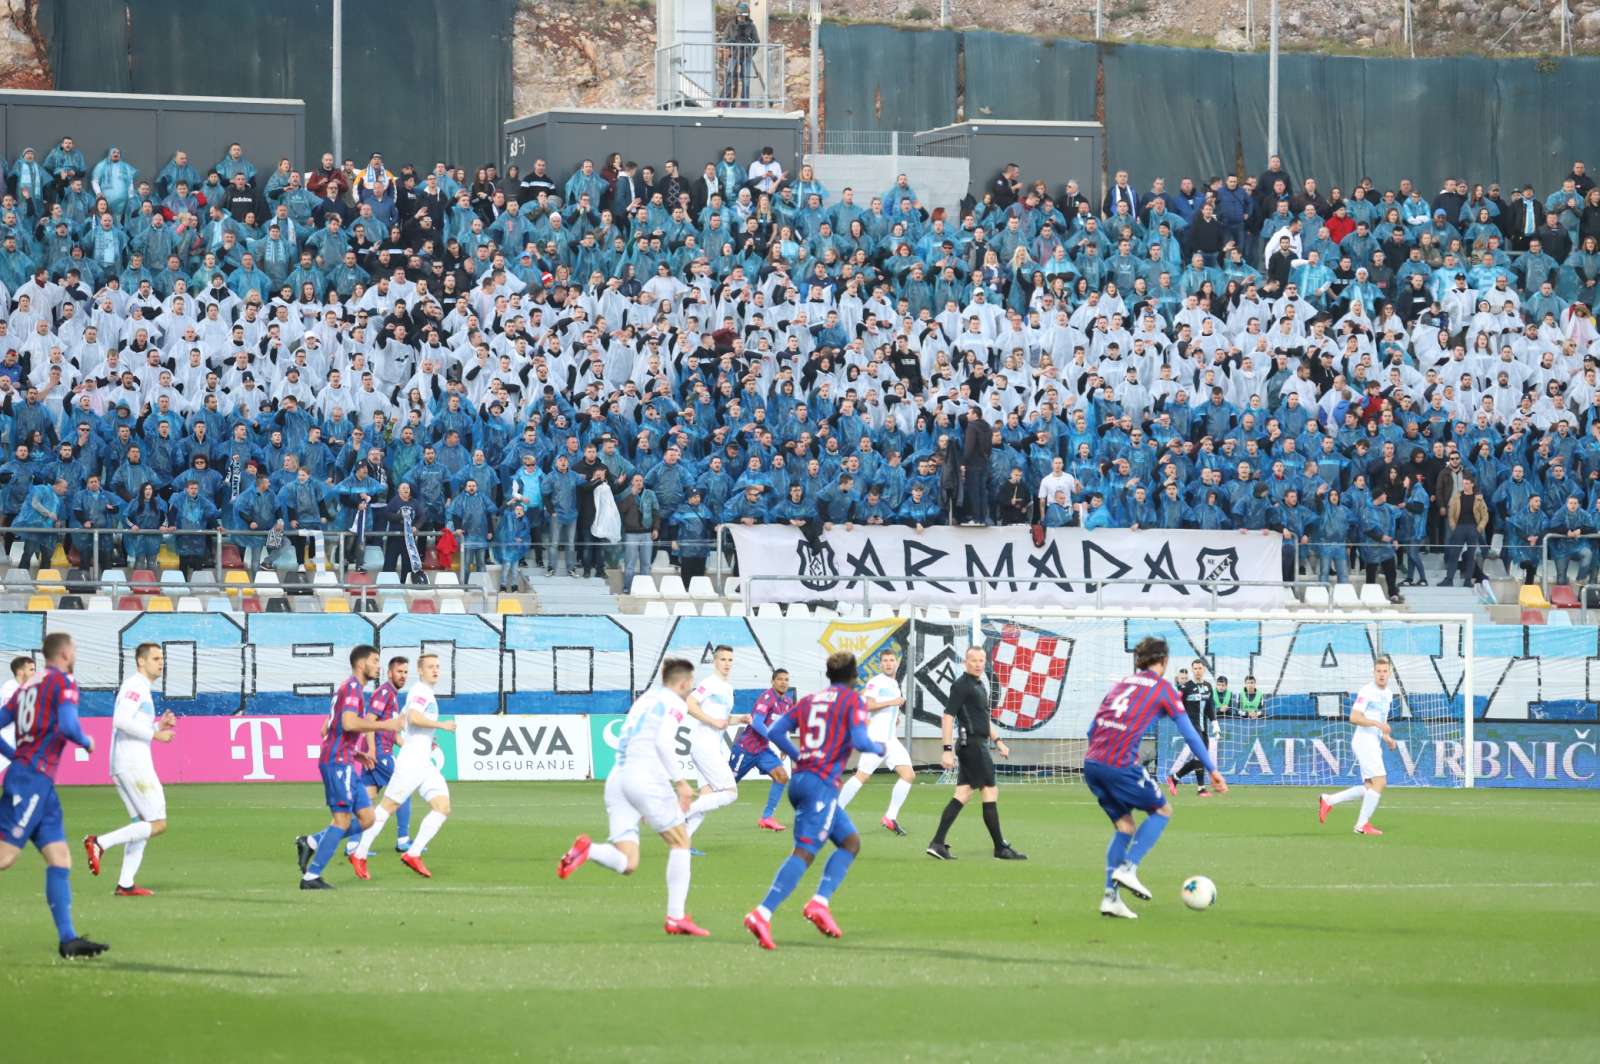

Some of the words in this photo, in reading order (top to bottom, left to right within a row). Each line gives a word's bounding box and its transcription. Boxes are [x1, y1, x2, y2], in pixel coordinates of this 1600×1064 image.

[845, 537, 1191, 596] ARMADA
[17, 687, 38, 735] 18
[1110, 685, 1137, 718] 4
[472, 726, 573, 756] SAVA
[805, 704, 827, 749] 5
[473, 760, 575, 771] OSIGURANJE
[1168, 736, 1361, 776] ZLATN
